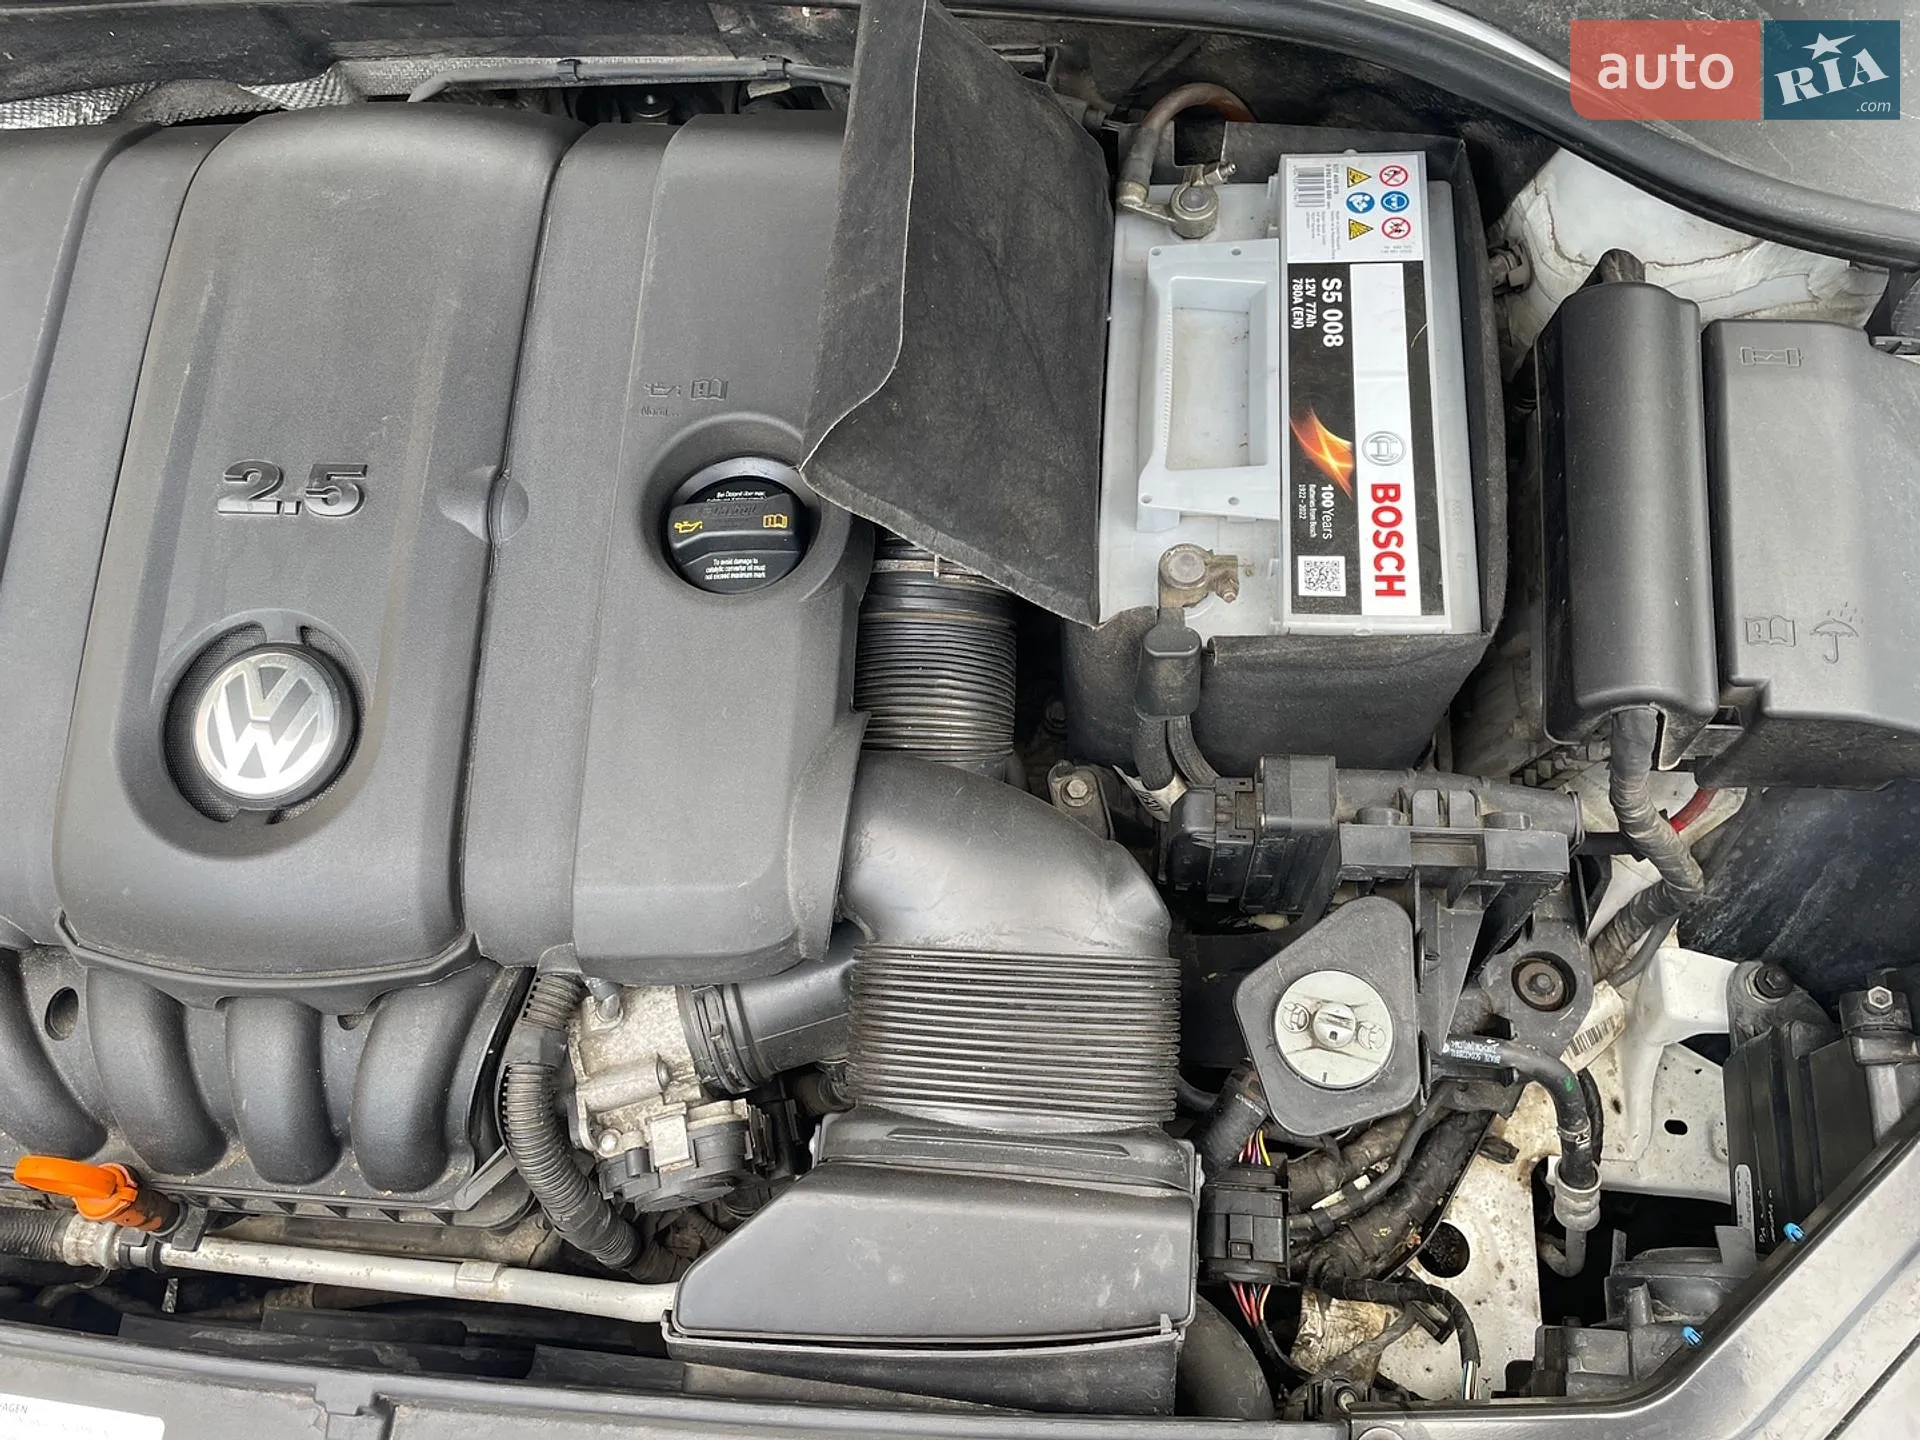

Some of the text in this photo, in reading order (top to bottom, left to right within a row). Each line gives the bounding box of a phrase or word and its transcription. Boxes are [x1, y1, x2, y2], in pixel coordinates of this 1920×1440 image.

[1291, 278, 1304, 330] 780A (EN)
[1305, 278, 1318, 328] 12V 77Ah
[1321, 278, 1343, 303] S5
[1322, 309, 1344, 347] 008
[217, 459, 368, 517] 2.5
[1309, 521, 1318, 538] Bosch
[1371, 483, 1406, 597] BOSCH
